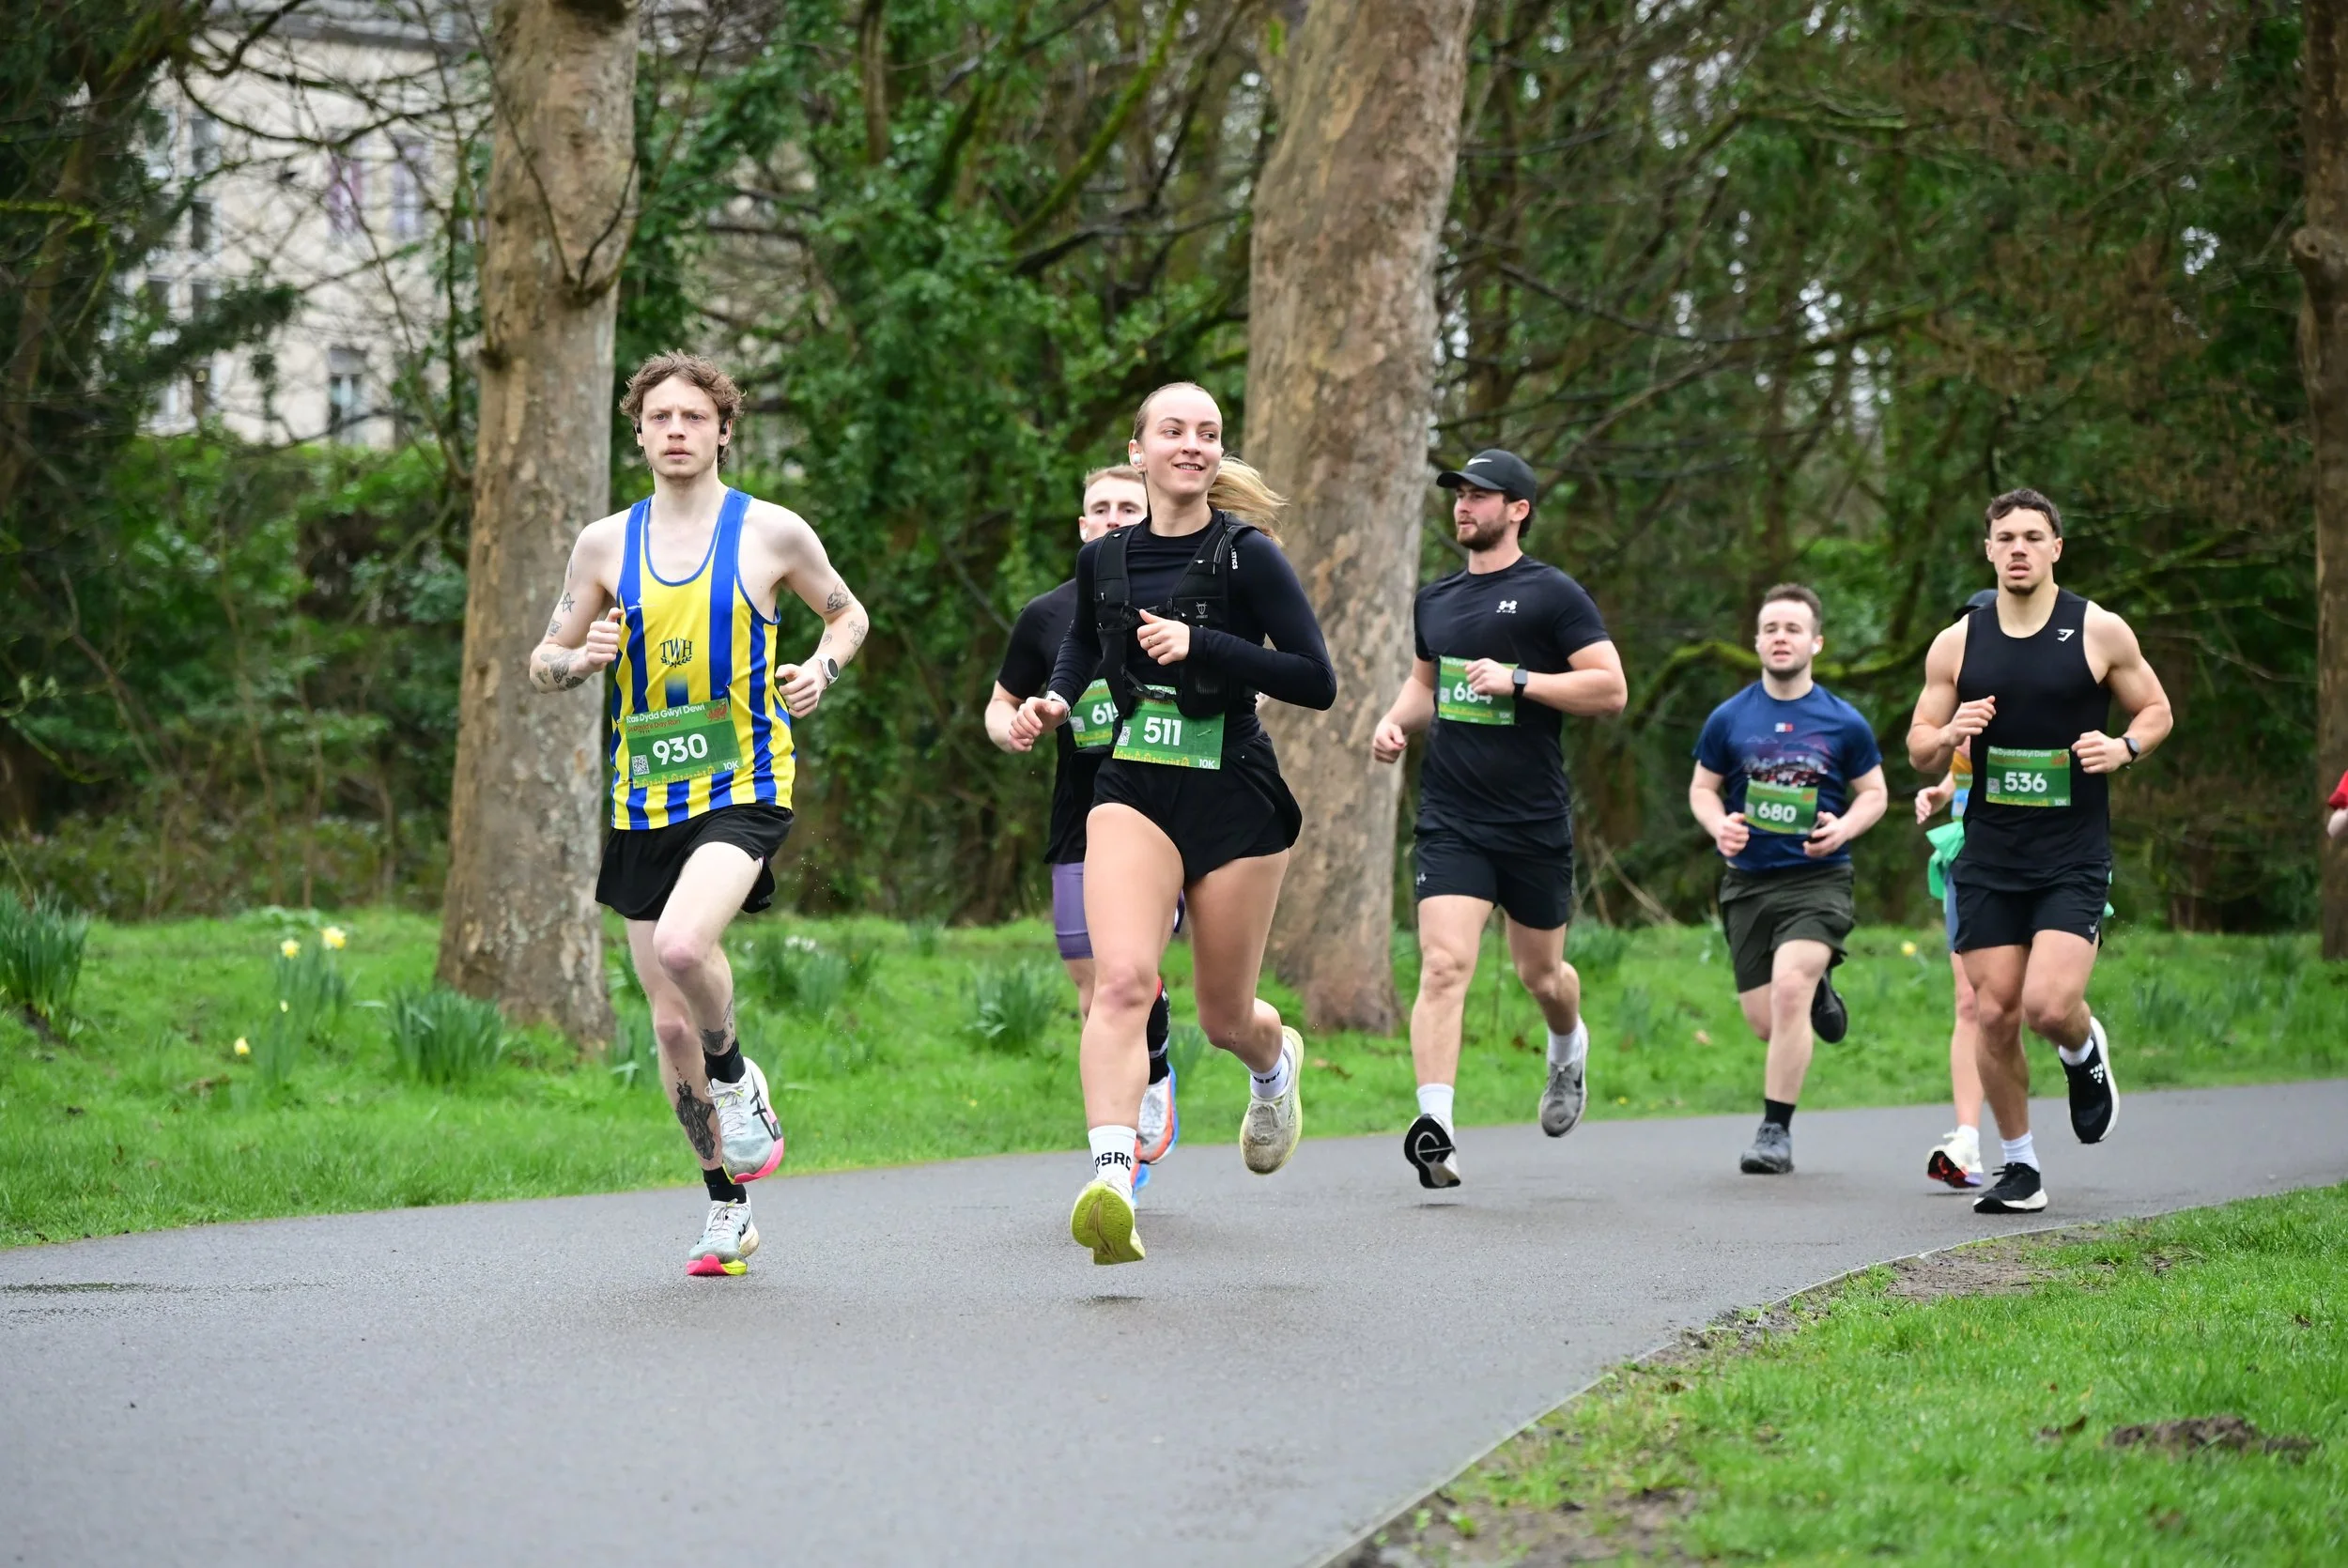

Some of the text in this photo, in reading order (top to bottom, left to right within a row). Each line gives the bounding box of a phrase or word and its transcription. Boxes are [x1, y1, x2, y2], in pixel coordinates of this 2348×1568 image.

[1229, 545, 1239, 570] LETICS
[659, 637, 692, 660] TWH
[626, 715, 639, 724] Ras
[640, 711, 659, 722] Dydd
[682, 704, 705, 714] Dewi
[1143, 716, 1182, 746] 511
[652, 733, 708, 765] 930
[723, 760, 739, 771] 10K
[1198, 758, 1216, 769] 10K
[2004, 772, 2047, 792] 536
[1757, 801, 1797, 822] 680
